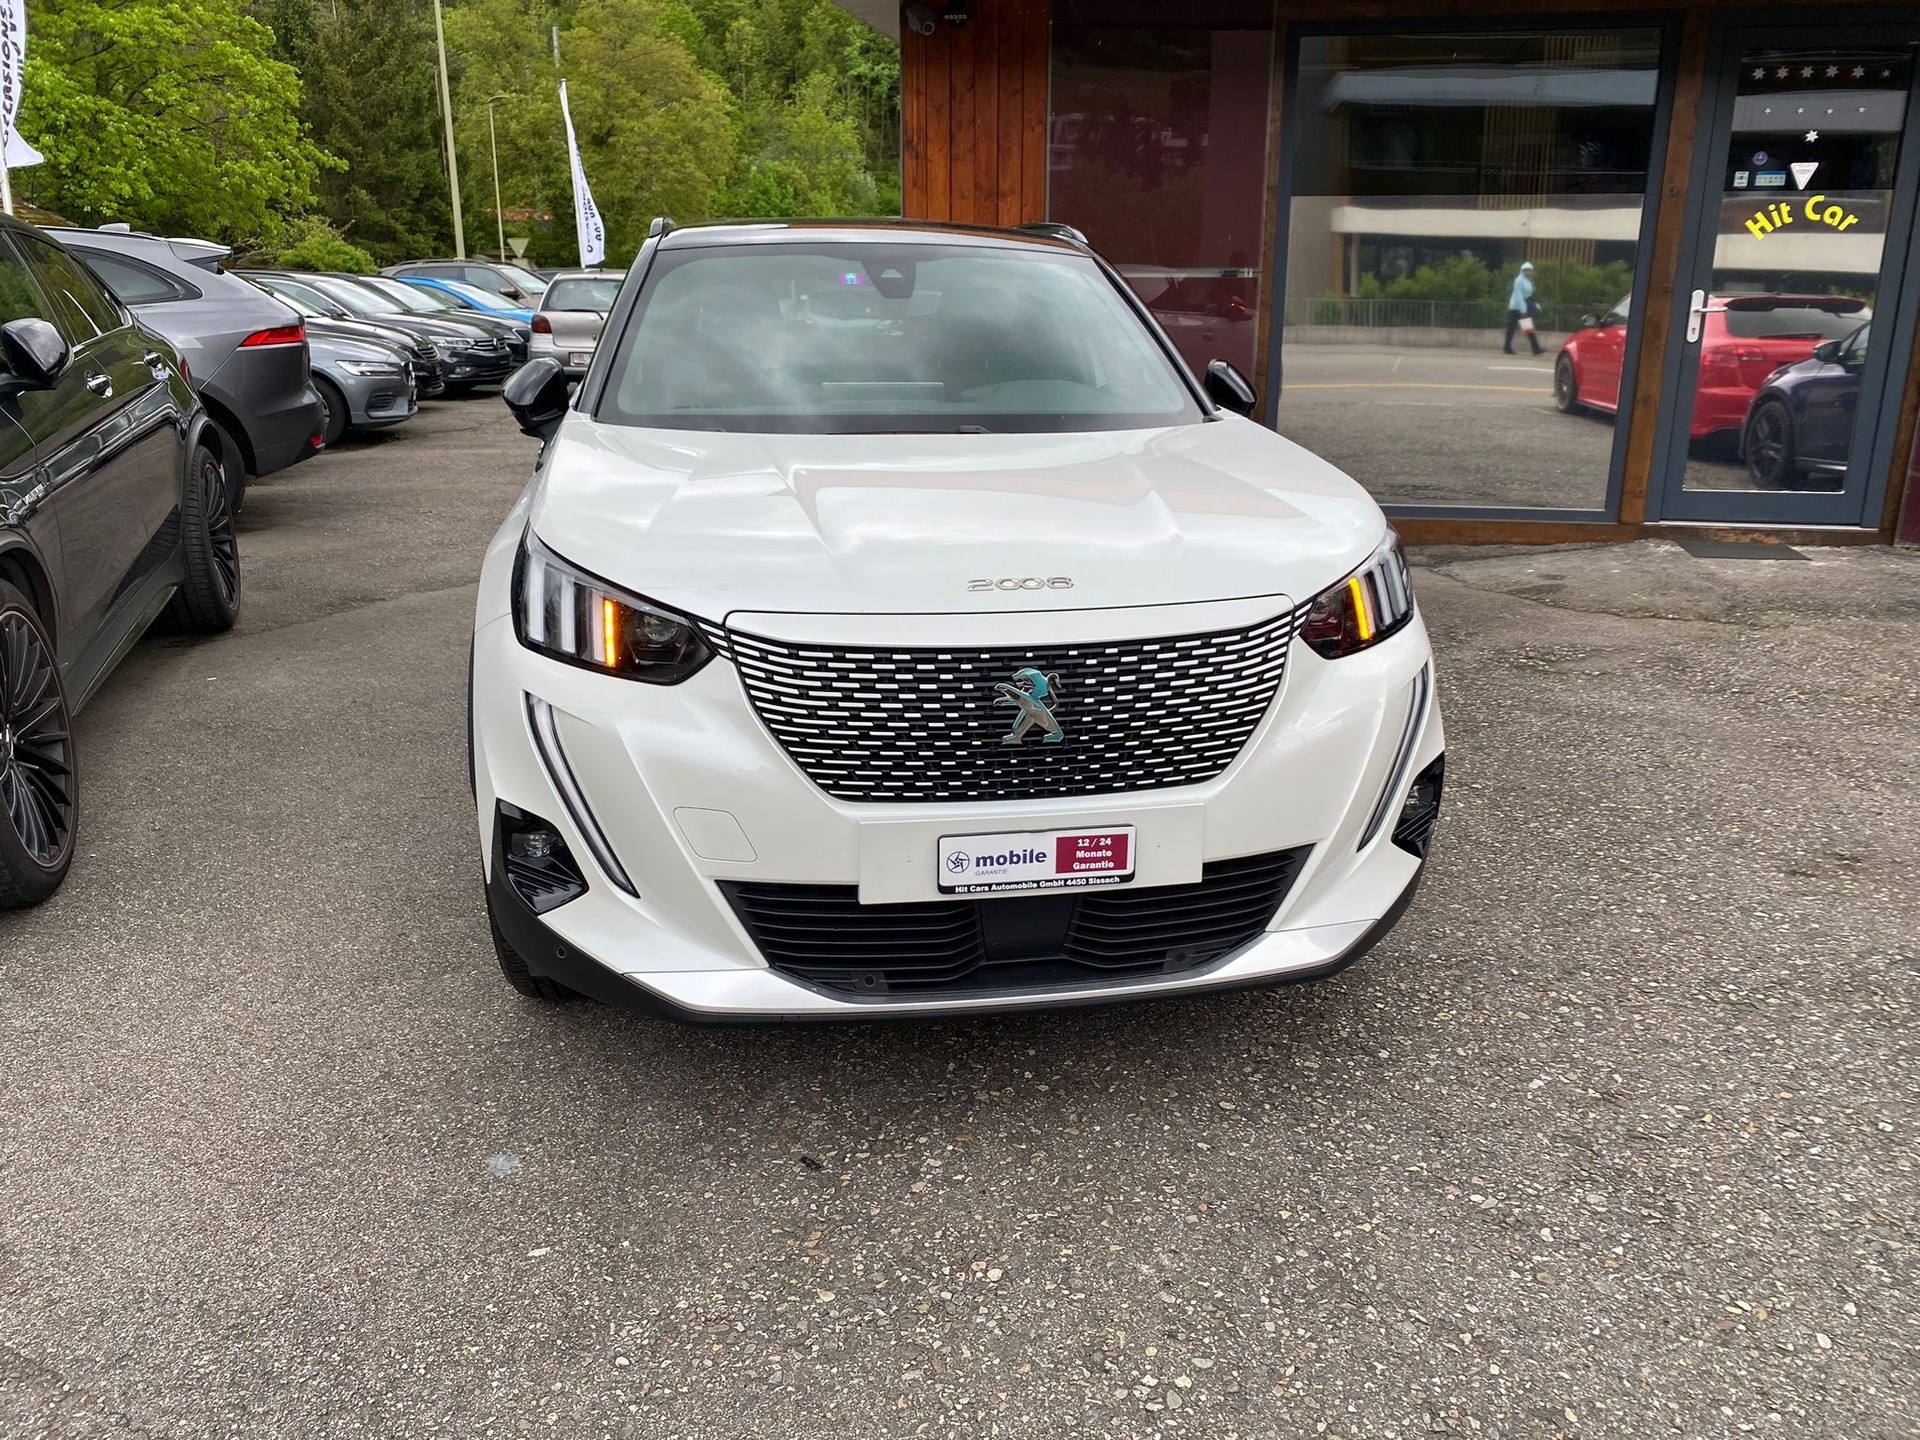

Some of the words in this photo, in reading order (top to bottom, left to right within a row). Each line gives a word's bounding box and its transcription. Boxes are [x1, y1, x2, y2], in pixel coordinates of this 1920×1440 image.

[1744, 202, 1793, 240] Hit
[1804, 195, 1859, 231] Car
[967, 577, 1074, 592] 2008
[1077, 839, 1090, 847] 12
[1099, 837, 1112, 846] 24
[975, 849, 1047, 867] mobile
[1076, 849, 1113, 858] Monate
[1073, 860, 1115, 870] Garantie
[975, 868, 1008, 876] GARANTIE
[991, 881, 1038, 891] Automobile
[1039, 880, 1064, 888] GmbH
[1088, 876, 1120, 884] Sissach
